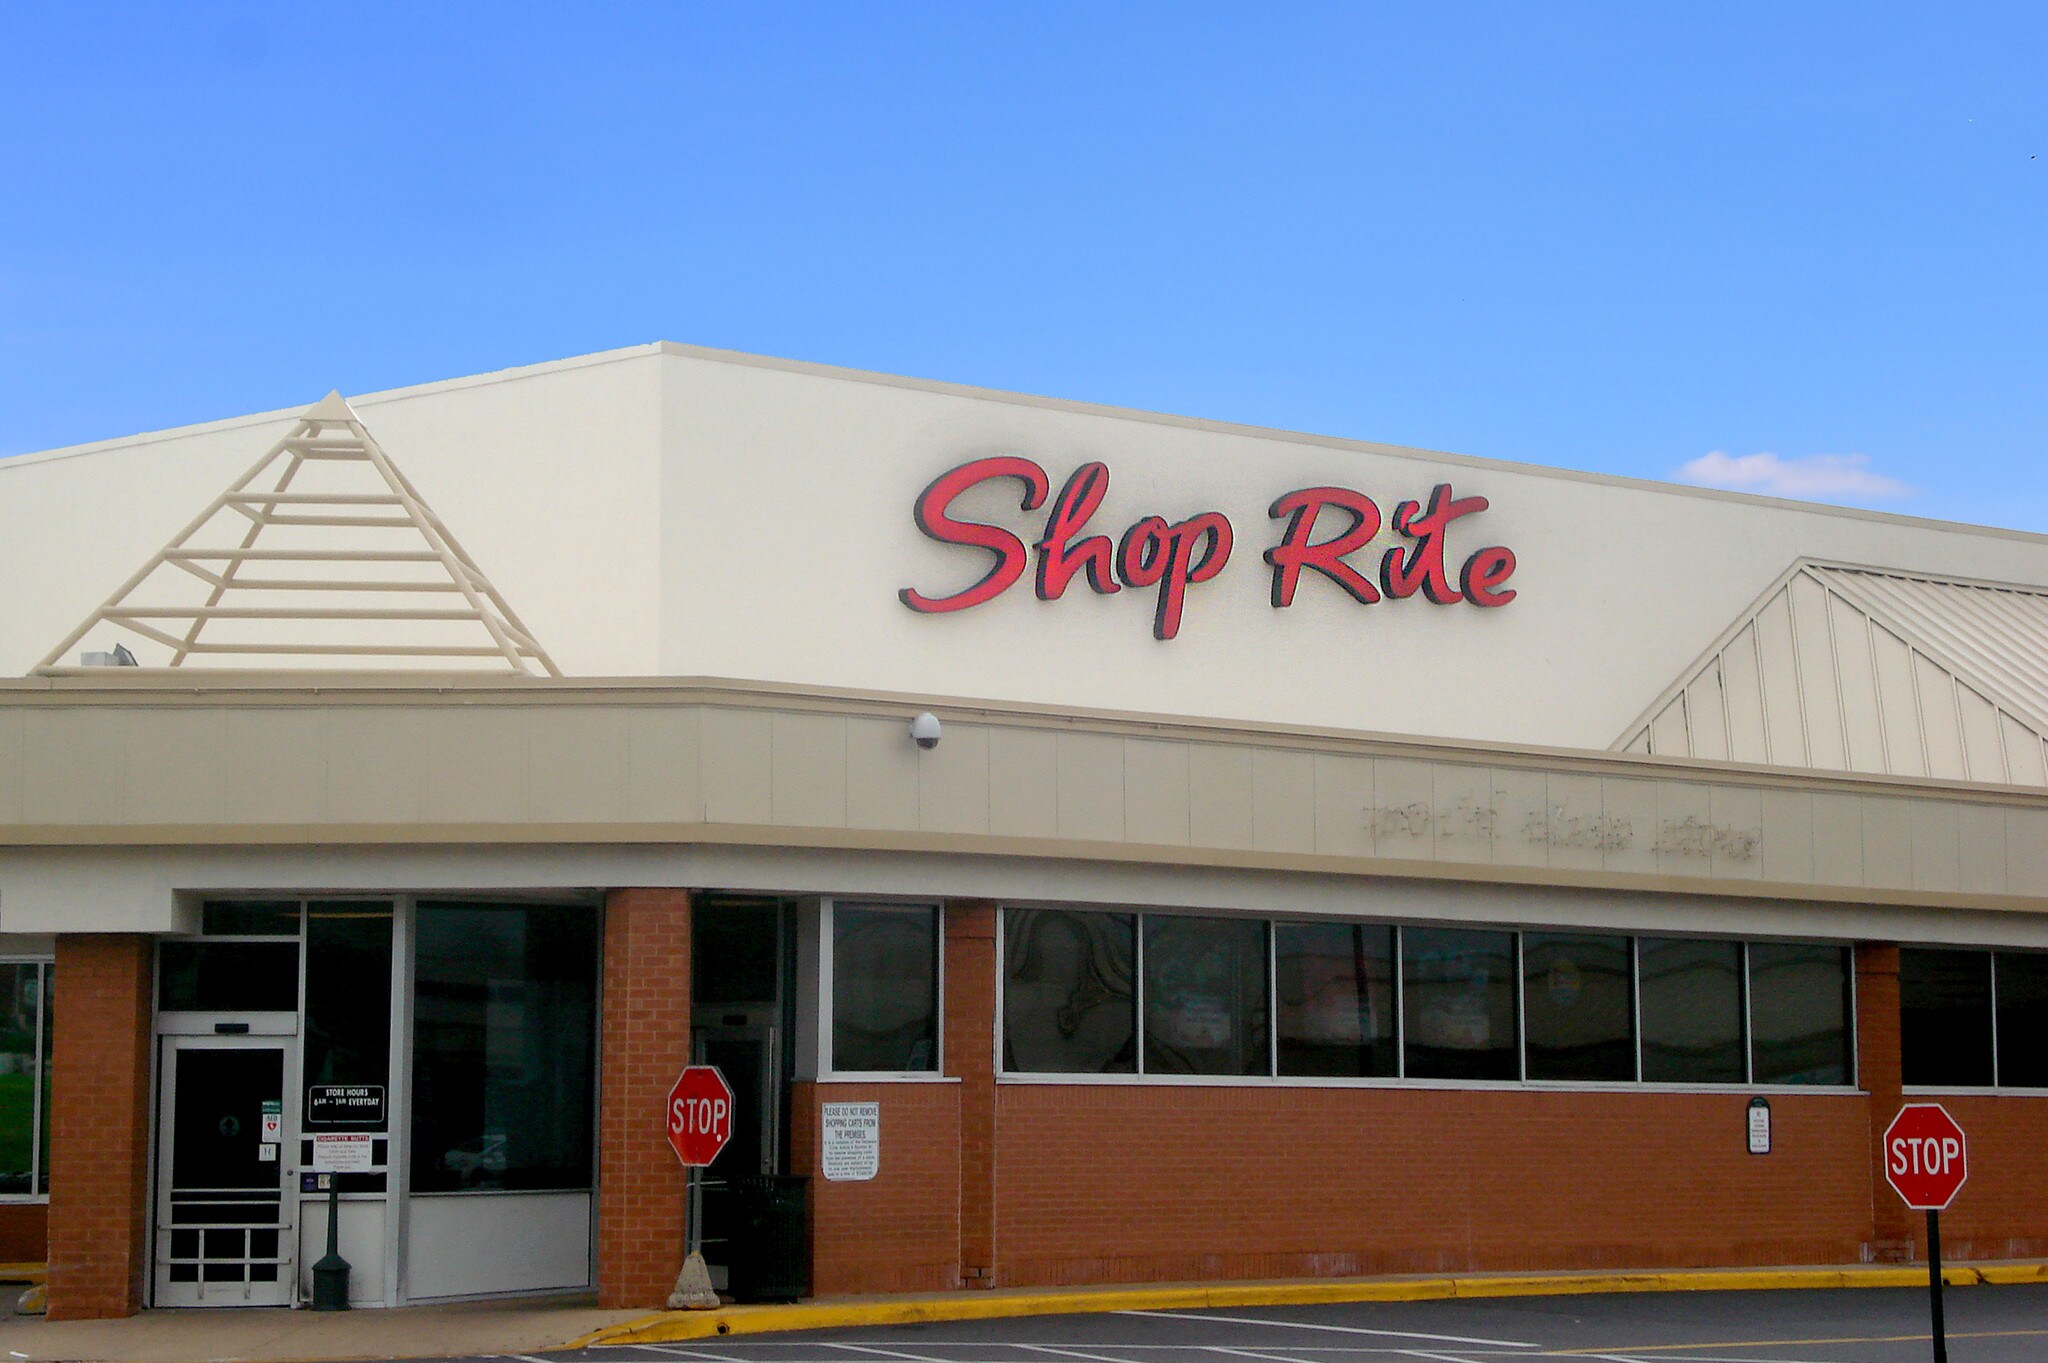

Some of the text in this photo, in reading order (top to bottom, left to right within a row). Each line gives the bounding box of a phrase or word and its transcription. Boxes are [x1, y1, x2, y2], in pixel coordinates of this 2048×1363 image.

[898, 455, 1517, 640] Shop Rite
[325, 1088, 369, 1097] STORE HOURS
[348, 1098, 380, 1106] EVERYDAY
[671, 1098, 727, 1135] STOP
[824, 1107, 877, 1117] PLEASE DO NOT REMOVE
[825, 1118, 876, 1128] SHOPPING CARTS FROM
[834, 1130, 843, 1139] THE
[1891, 1137, 1960, 1176] STOP
